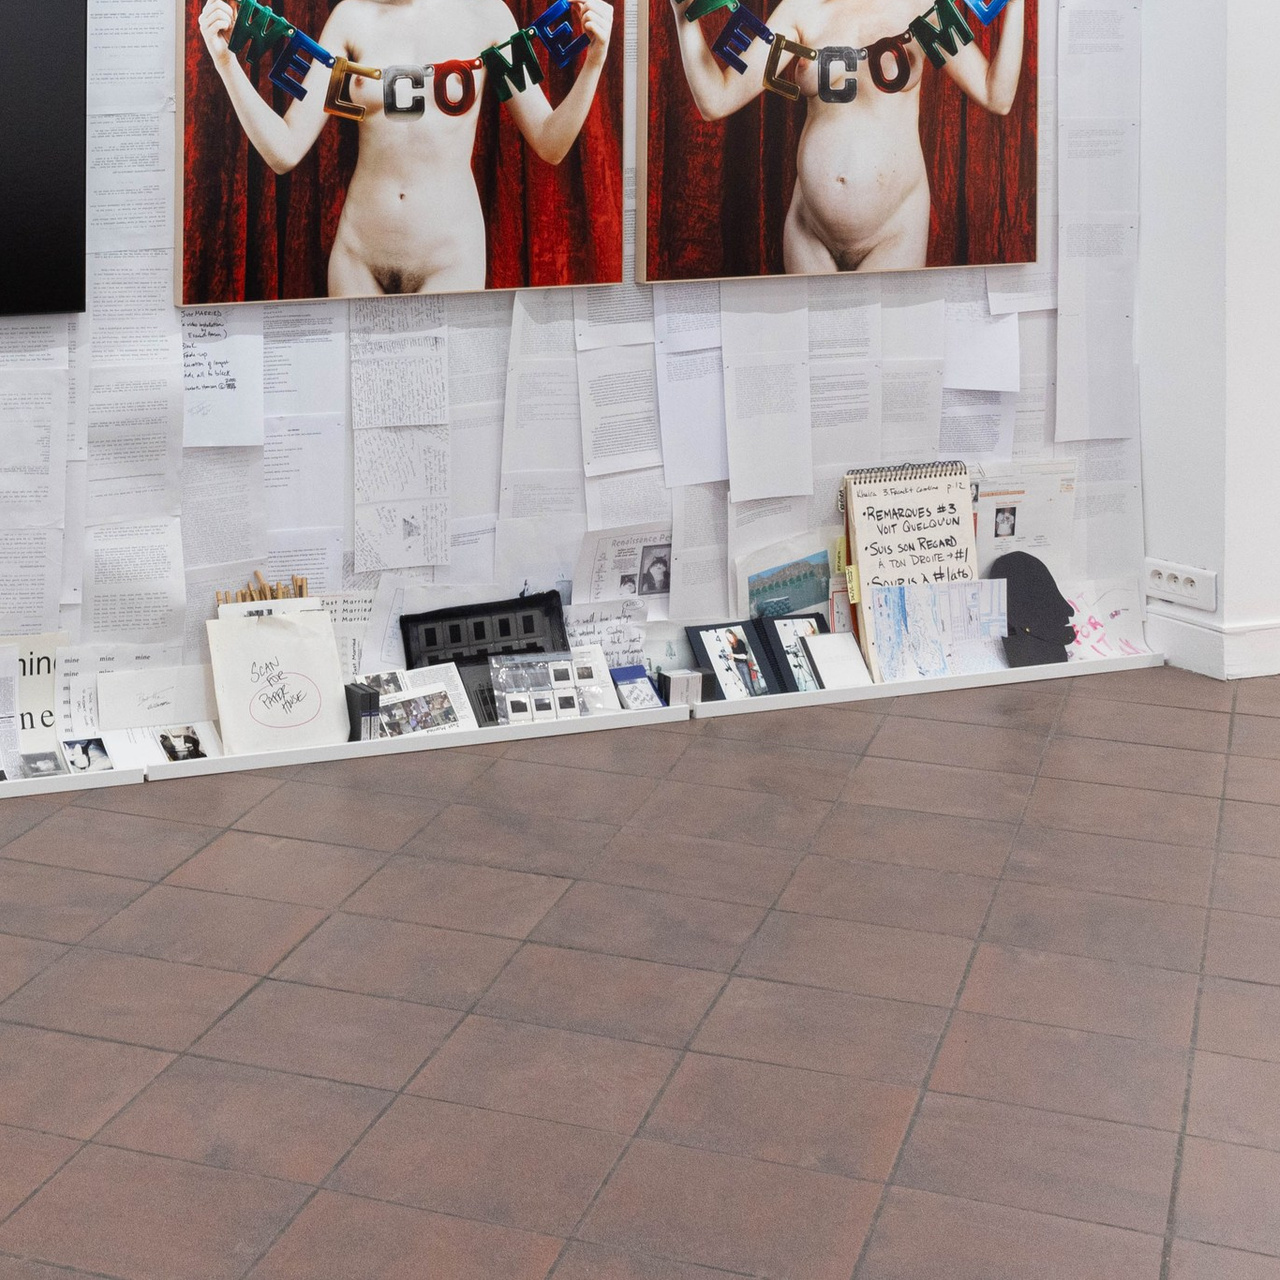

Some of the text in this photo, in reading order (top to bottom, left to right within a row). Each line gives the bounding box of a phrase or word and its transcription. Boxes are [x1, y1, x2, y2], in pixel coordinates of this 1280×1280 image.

[866, 503, 957, 522] REMARQUES #3
[876, 516, 960, 536] VOIT QUELQU'UN
[611, 536, 658, 548] Renaissance
[869, 535, 958, 557] SUIS SON REGARD
[889, 558, 907, 569] TON
[909, 551, 945, 567] DROITE
[342, 598, 373, 606] Married
[18, 651, 56, 676] in
[64, 656, 80, 664] mine
[63, 670, 79, 678] mine
[250, 655, 280, 684] SCAN
